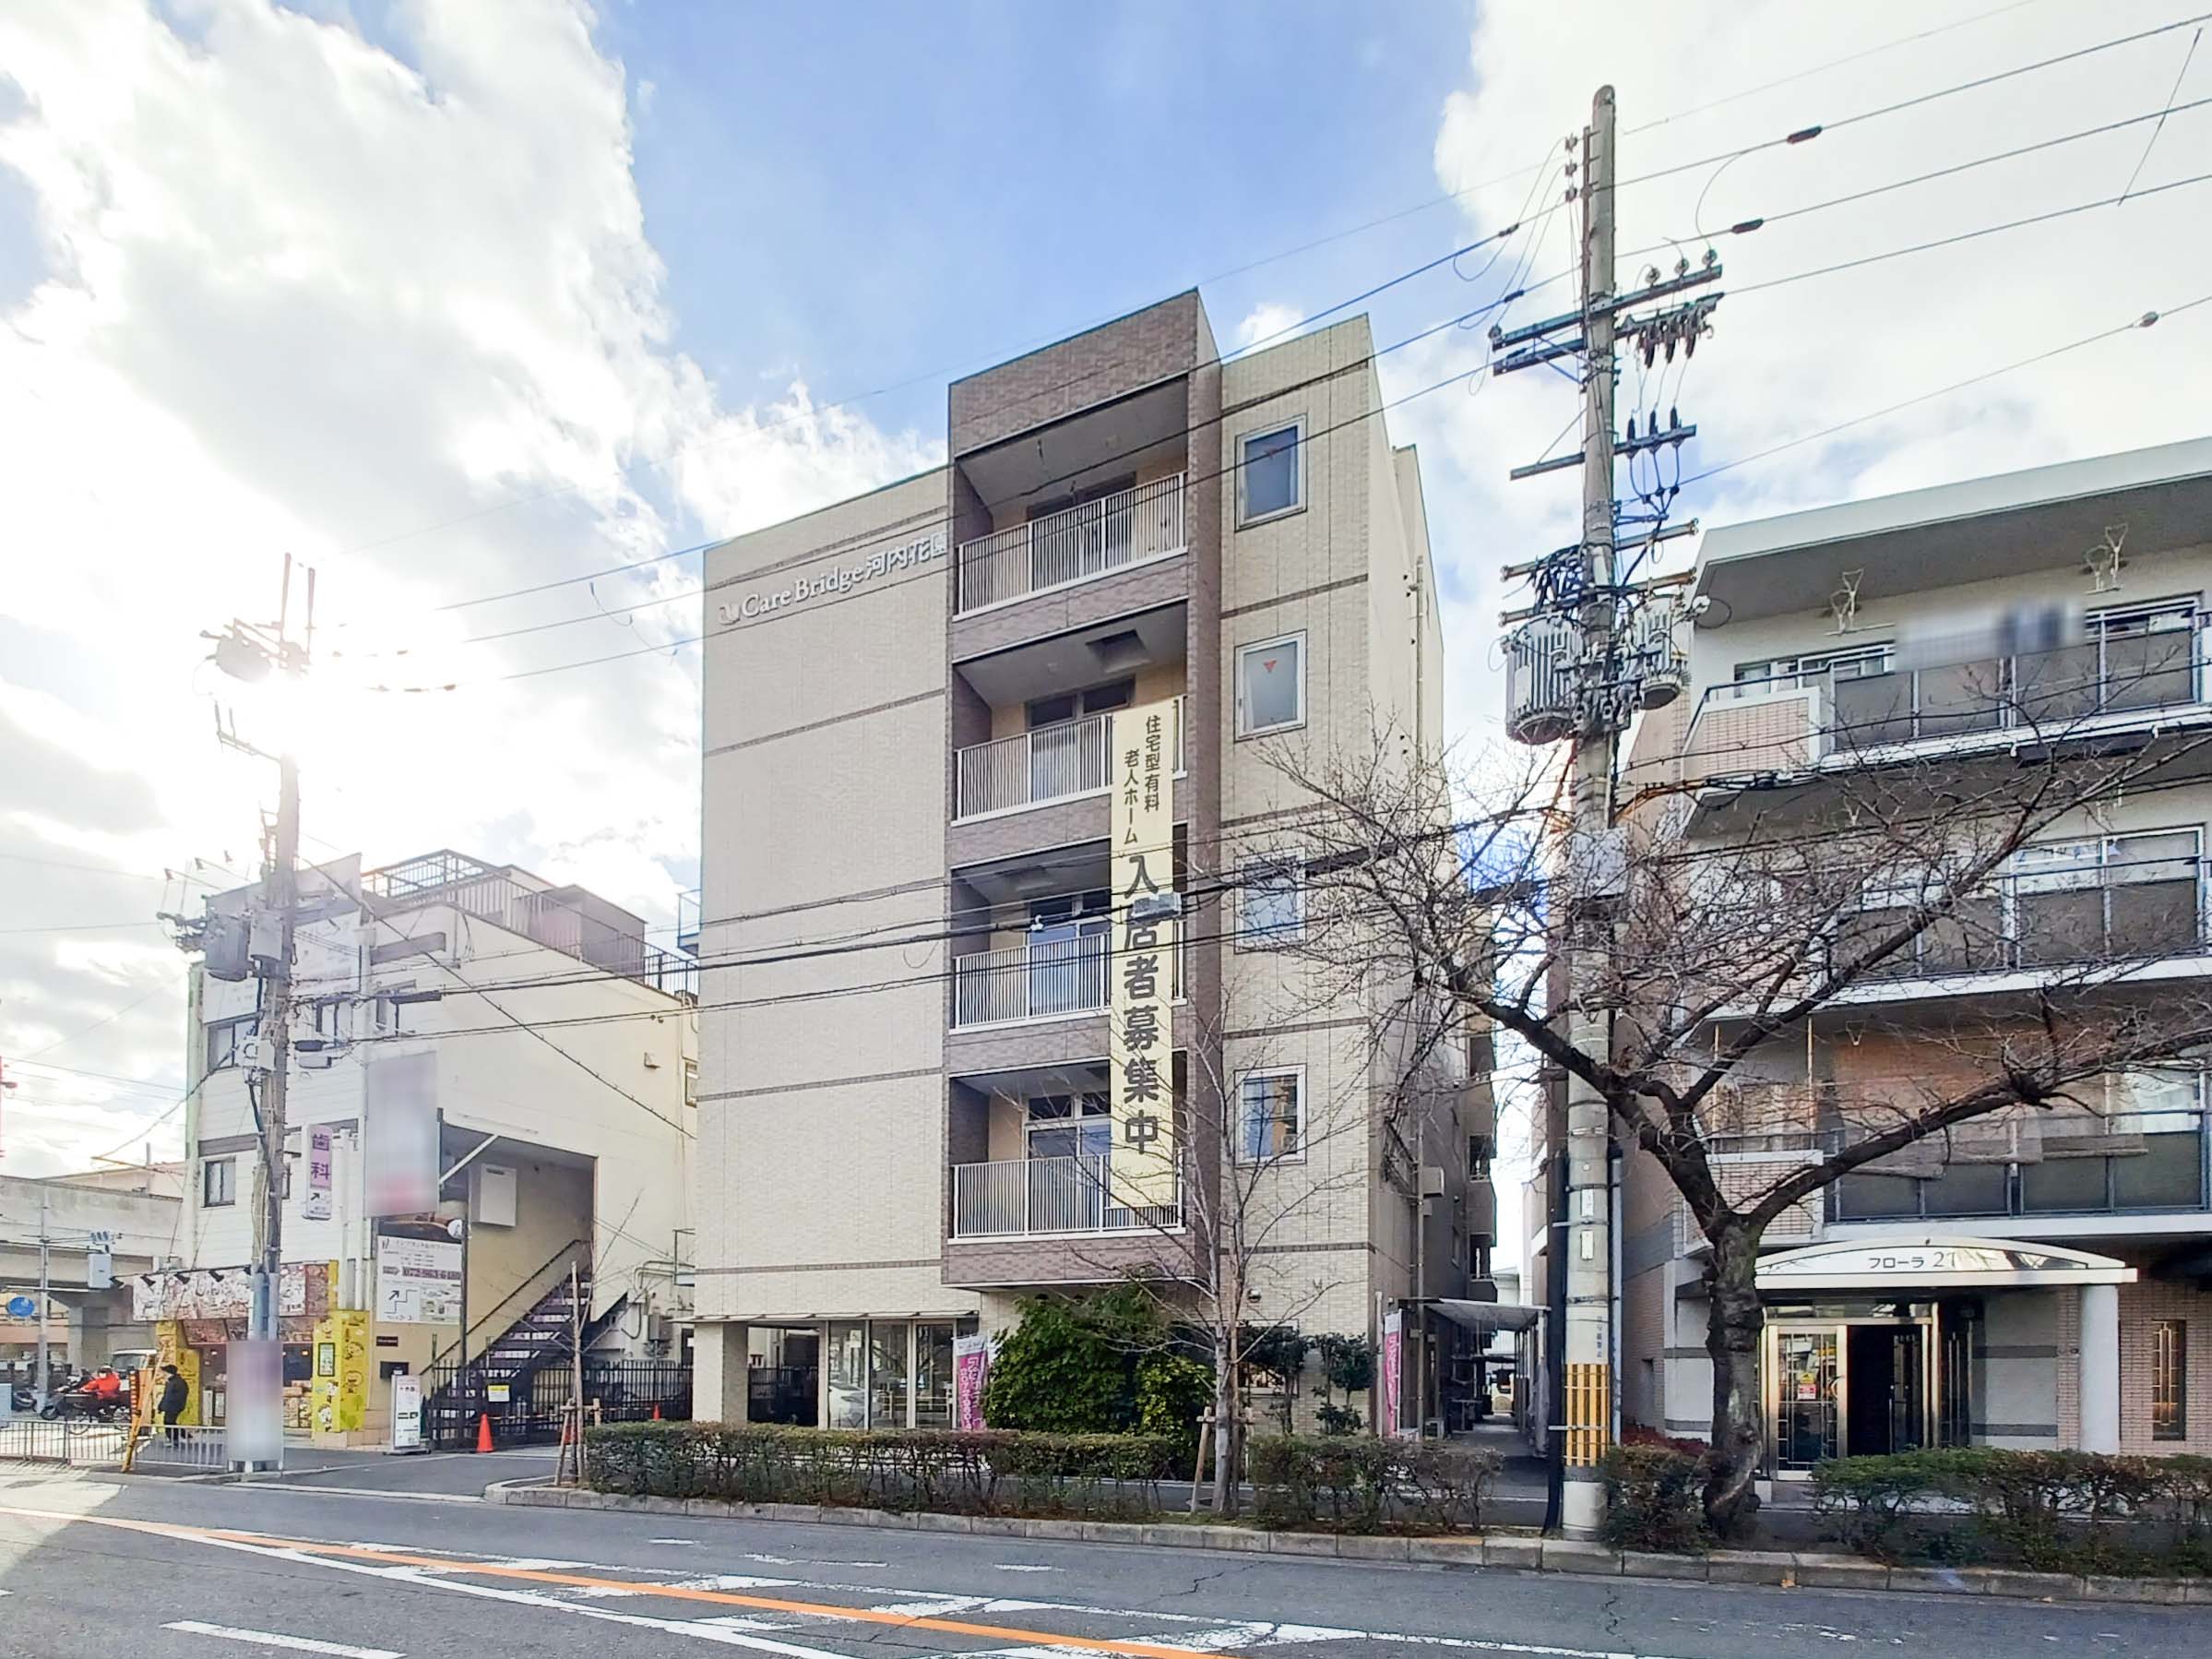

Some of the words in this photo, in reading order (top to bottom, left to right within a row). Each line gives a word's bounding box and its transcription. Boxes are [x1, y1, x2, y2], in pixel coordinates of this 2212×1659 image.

[742, 587, 791, 617] Care
[794, 565, 864, 602] Bridge
[1144, 714, 1161, 813] 住宅型有料
[1124, 748, 1140, 845] 老人ホーム
[310, 1132, 331, 1181] 歯科
[1869, 1256, 1925, 1270] フローラ
